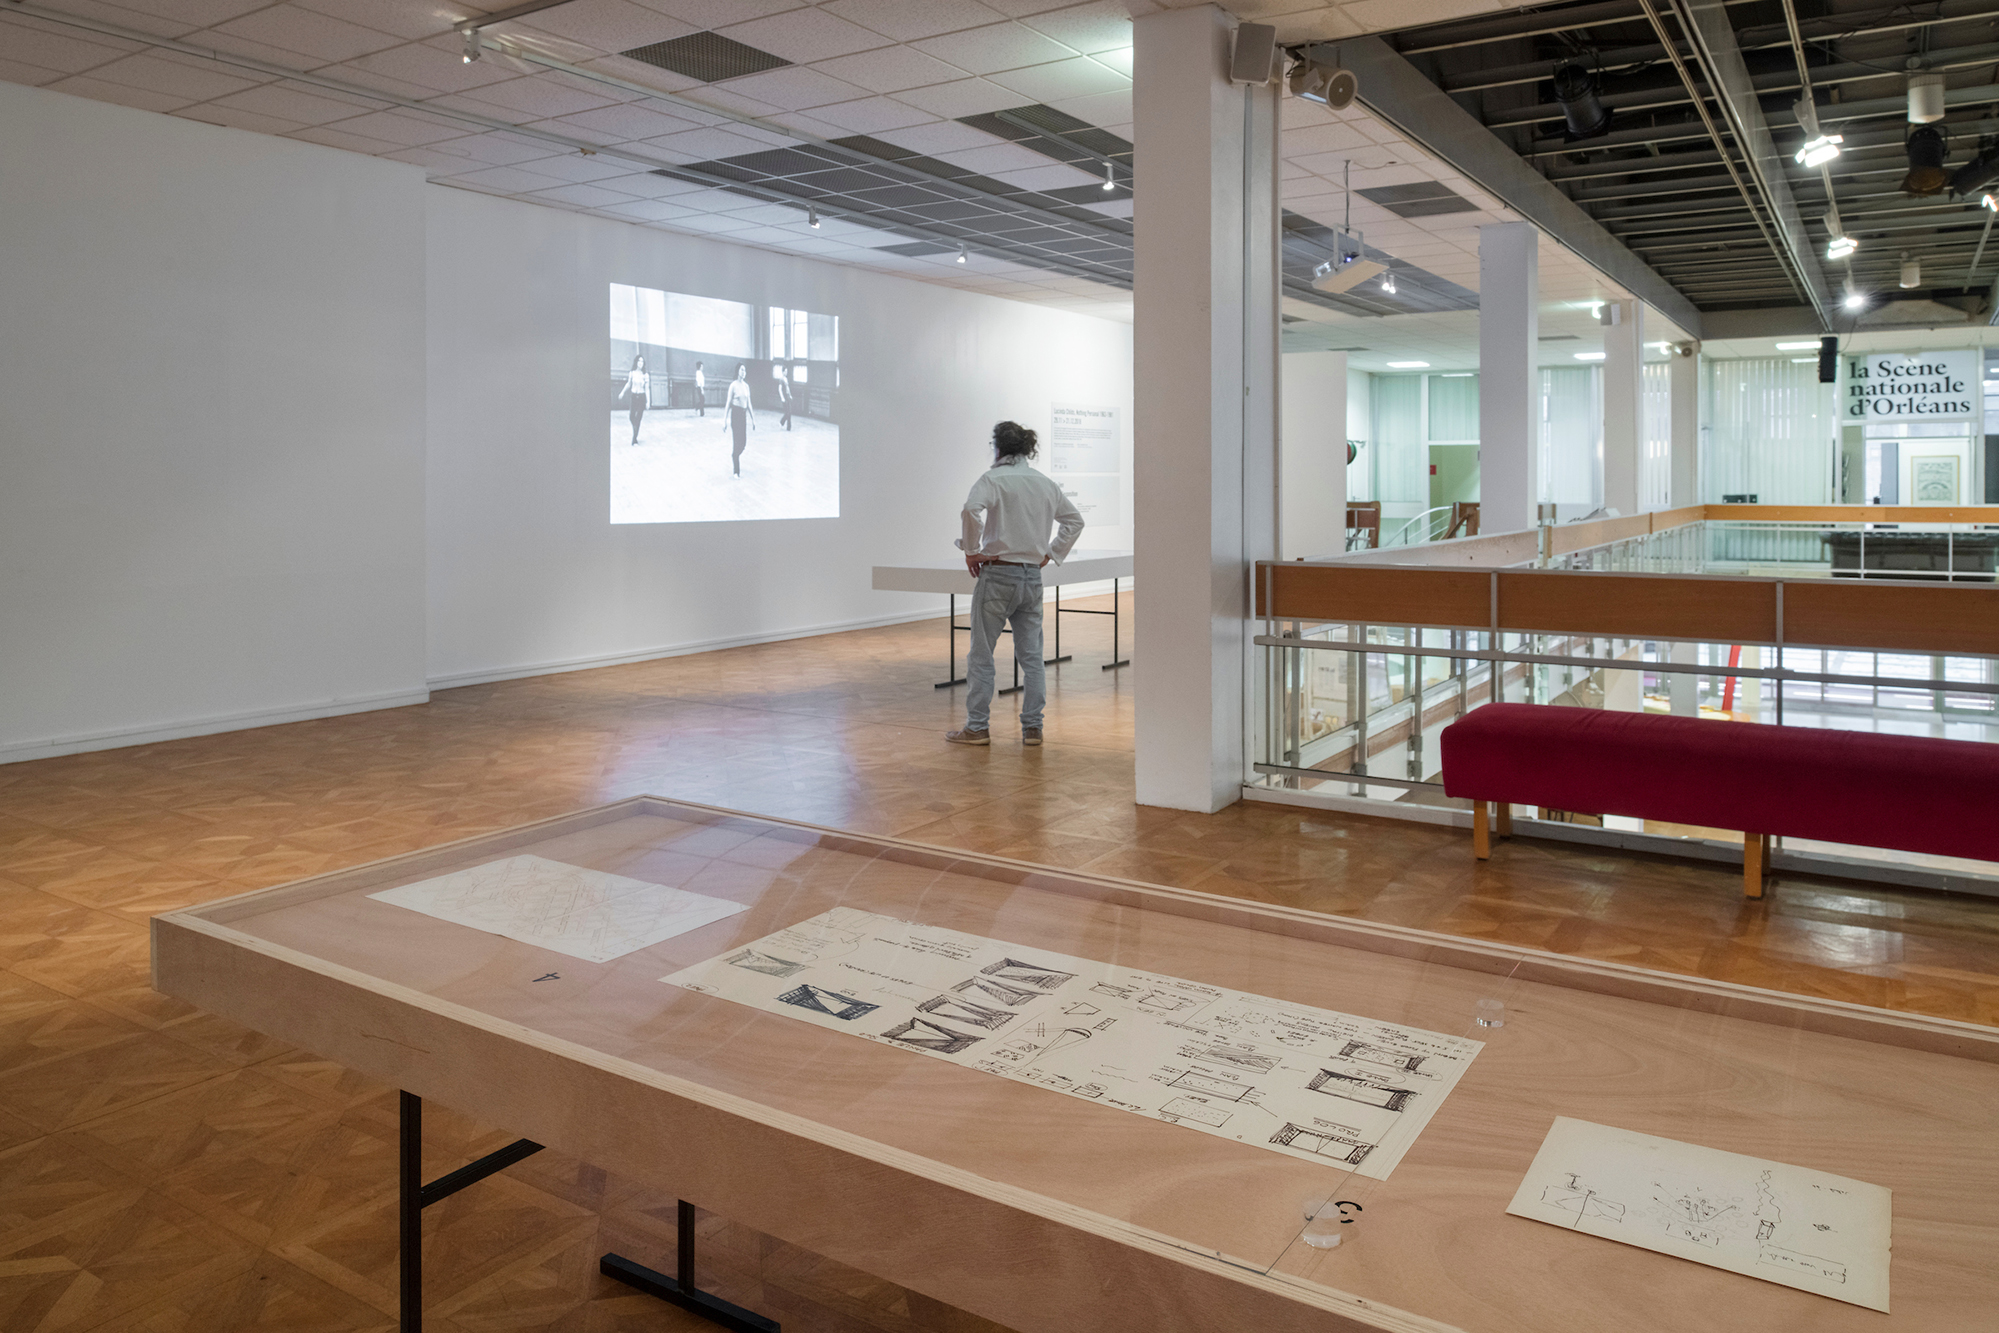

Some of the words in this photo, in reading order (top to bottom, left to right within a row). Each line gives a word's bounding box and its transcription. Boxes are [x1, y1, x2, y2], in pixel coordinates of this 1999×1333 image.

[1849, 361, 1870, 379] la
[1877, 358, 1948, 378] Scène
[1849, 376, 1965, 396] nationale
